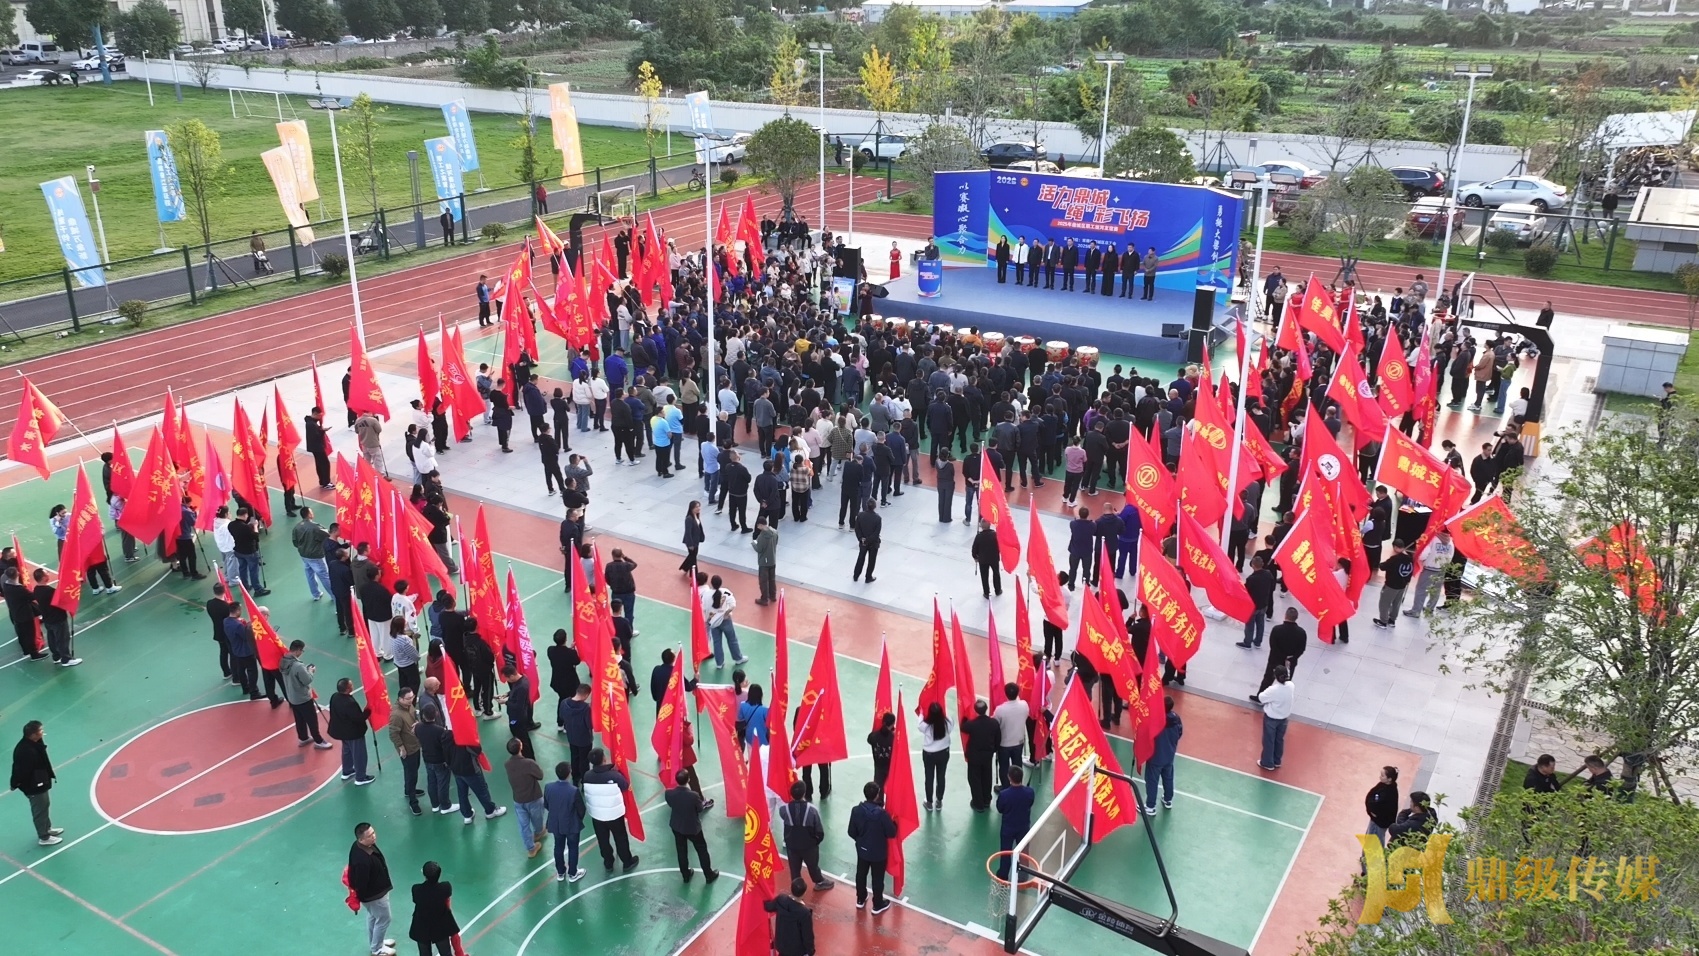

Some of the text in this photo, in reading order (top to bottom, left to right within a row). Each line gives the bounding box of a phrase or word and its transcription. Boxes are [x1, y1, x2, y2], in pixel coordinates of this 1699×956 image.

[957, 182, 970, 255] 以赛凝心聚合力
[1037, 184, 1111, 209] 活力鼎城
